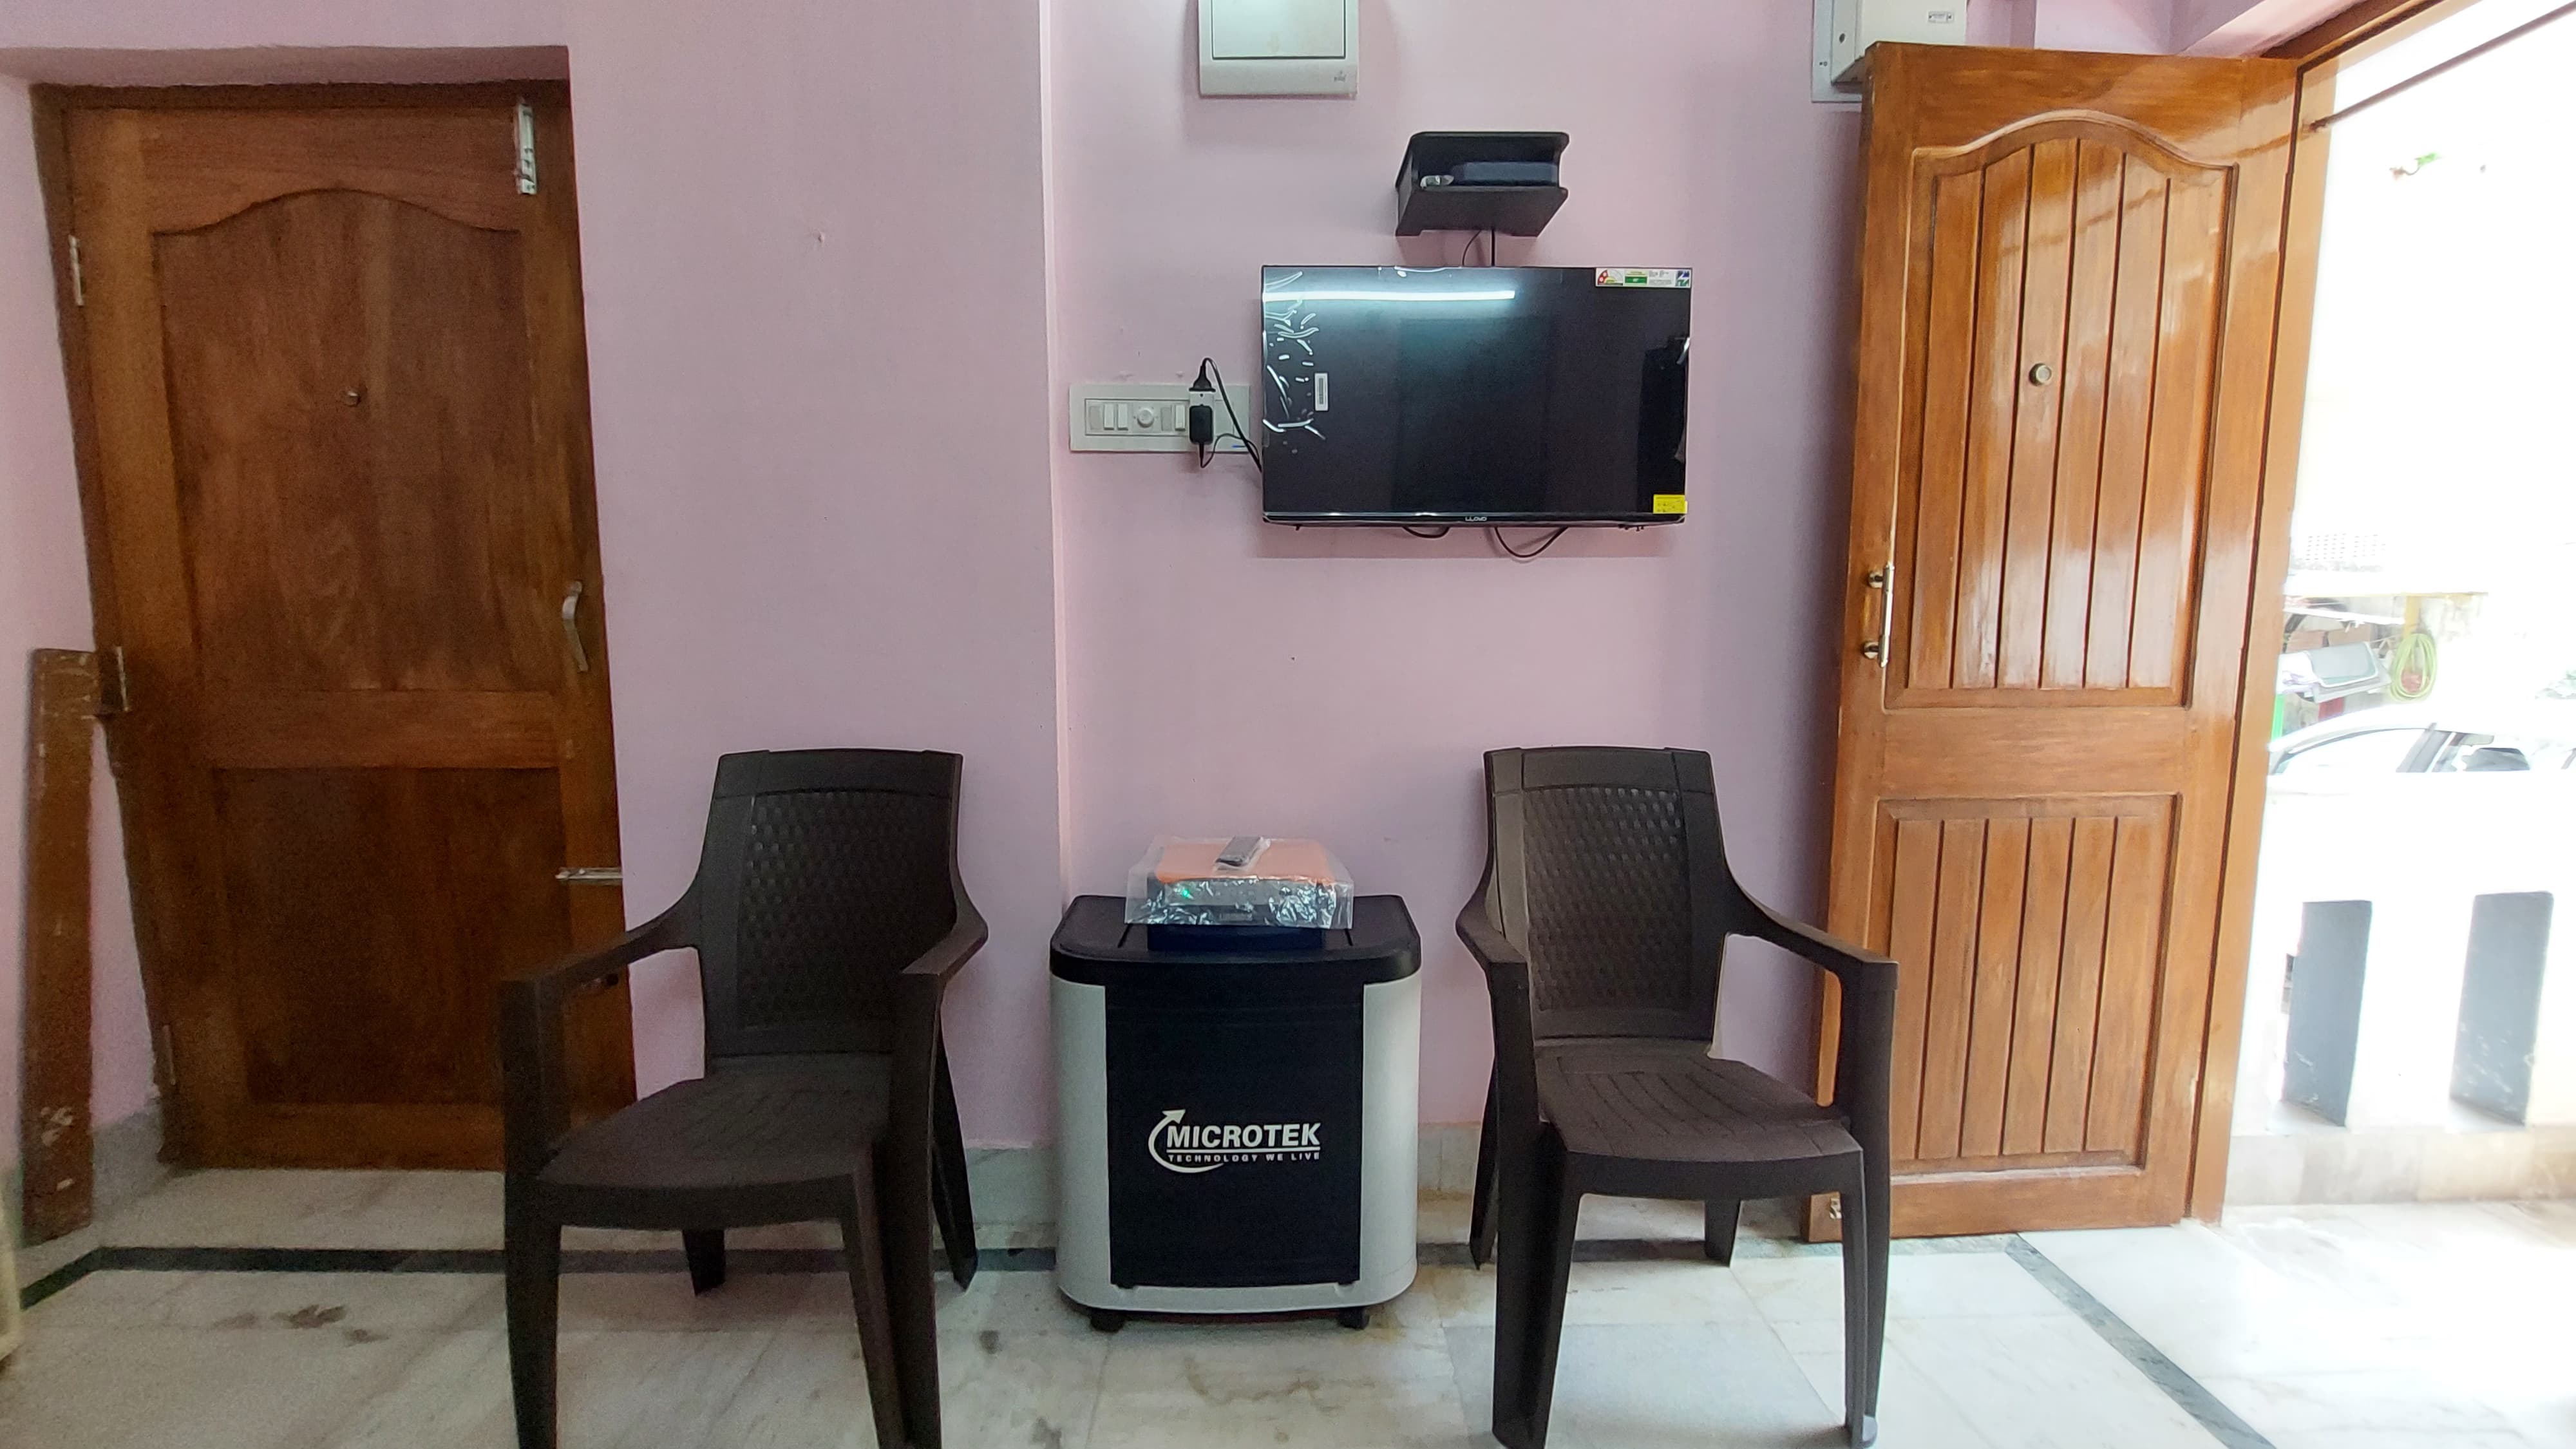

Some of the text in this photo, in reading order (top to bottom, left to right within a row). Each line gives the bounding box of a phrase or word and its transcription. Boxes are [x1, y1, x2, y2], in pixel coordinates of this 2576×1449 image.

[1166, 1122, 1321, 1148] MICROTEK
[1168, 1154, 1258, 1162] TECHNOLOGY
[1291, 1152, 1320, 1161] LIVE
